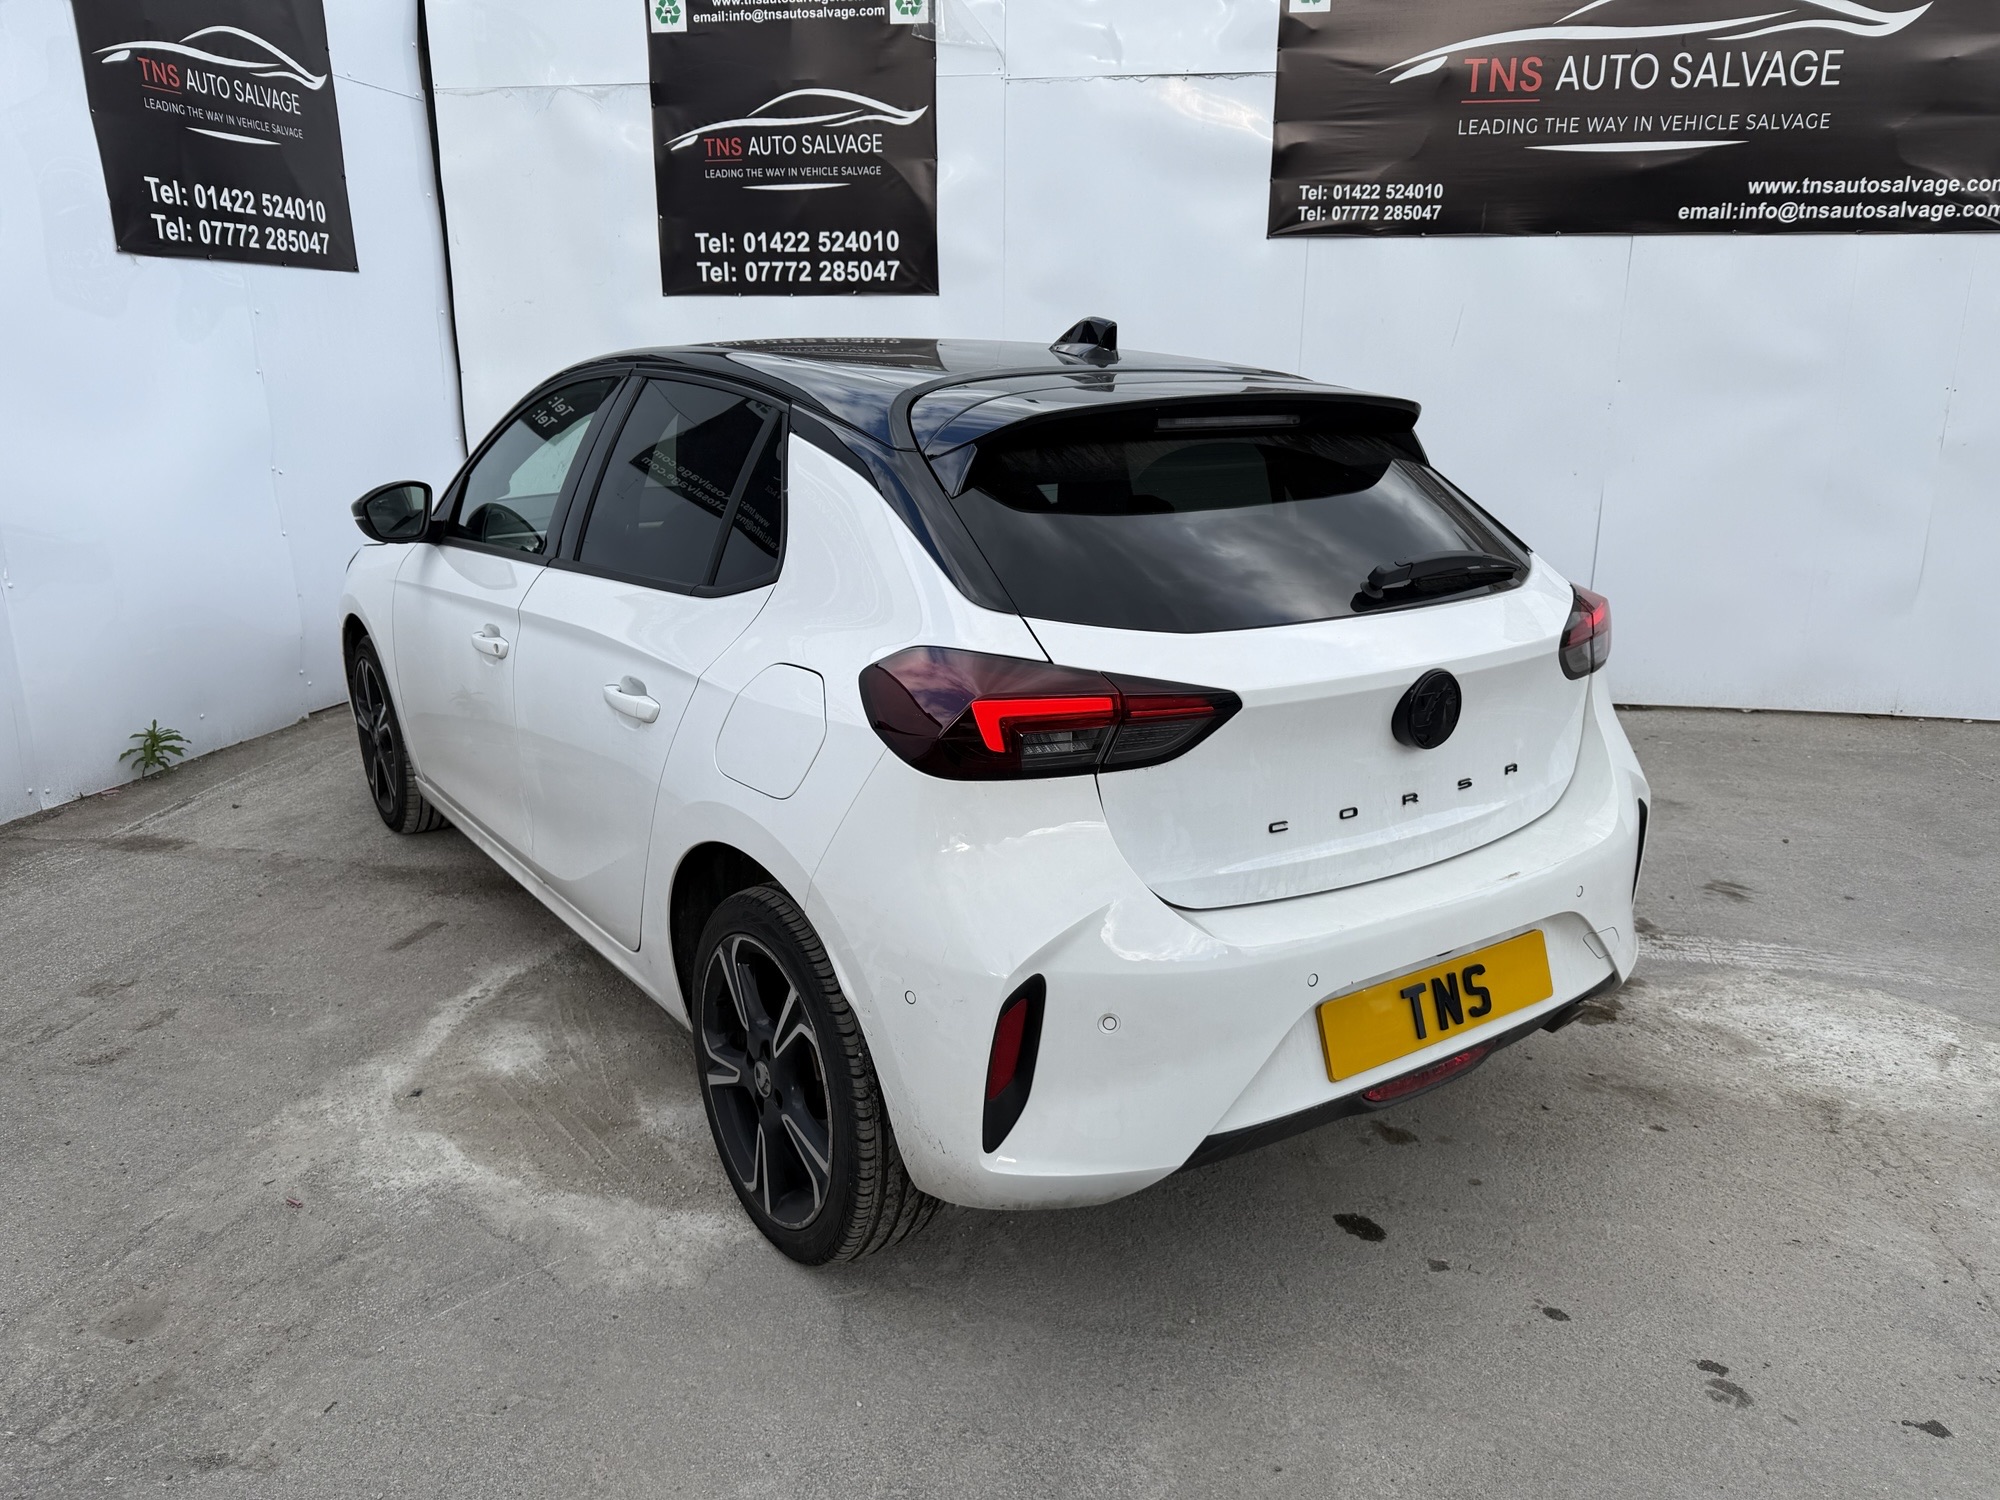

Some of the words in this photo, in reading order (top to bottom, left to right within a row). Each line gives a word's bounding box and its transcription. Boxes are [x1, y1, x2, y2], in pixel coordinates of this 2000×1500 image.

[693, 6, 885, 23] email:info@tnsautosalvage.com
[1464, 55, 1544, 93] TNS
[1555, 52, 1660, 91] AUTO
[1670, 49, 1844, 88] SALVAGE
[137, 57, 181, 87] TNS
[186, 68, 230, 98] AUTO
[234, 80, 302, 115] SALVAGE
[143, 97, 186, 115] LEADING
[186, 105, 204, 120] THE
[205, 109, 224, 124] WAY
[225, 114, 235, 126] IN
[235, 116, 270, 133] VEHICLE
[271, 123, 303, 140] SALVAGE
[1458, 118, 1539, 135] LEADING
[1545, 117, 1579, 134] THE
[1585, 116, 1628, 132] WAY
[1633, 115, 1654, 132] IN
[1659, 113, 1739, 131] VEHICLE
[1745, 112, 1832, 130] SALVAGE
[704, 137, 742, 157] TNS
[748, 135, 797, 155] AUTO
[801, 133, 883, 154] SALVAGE
[705, 168, 744, 179] LEADING
[745, 168, 763, 178] THE
[765, 167, 786, 177] WAY
[788, 167, 798, 177] IN
[800, 166, 839, 176] VEHICLE
[840, 165, 882, 176] SALVAGE
[143, 176, 188, 207] Tel:
[194, 183, 257, 215] 01422
[261, 193, 326, 223] 524010
[1299, 185, 1327, 200] Tel:
[1333, 184, 1381, 200] 01422
[1385, 183, 1443, 199] 524010
[1298, 206, 1326, 221] Tel:
[1331, 205, 1379, 220] 07772
[1383, 205, 1442, 220] 285047
[150, 213, 193, 243] Tel:
[199, 219, 260, 248] 07772
[265, 226, 329, 255] 285047
[694, 232, 736, 253] Tel:
[743, 231, 810, 253] 01422
[818, 230, 900, 252] 524010
[696, 261, 737, 282] Tel:
[745, 260, 812, 282] 07772
[819, 260, 900, 282] 285047
[1268, 762, 1518, 833] CORSA
[1400, 964, 1492, 1040] TNS
